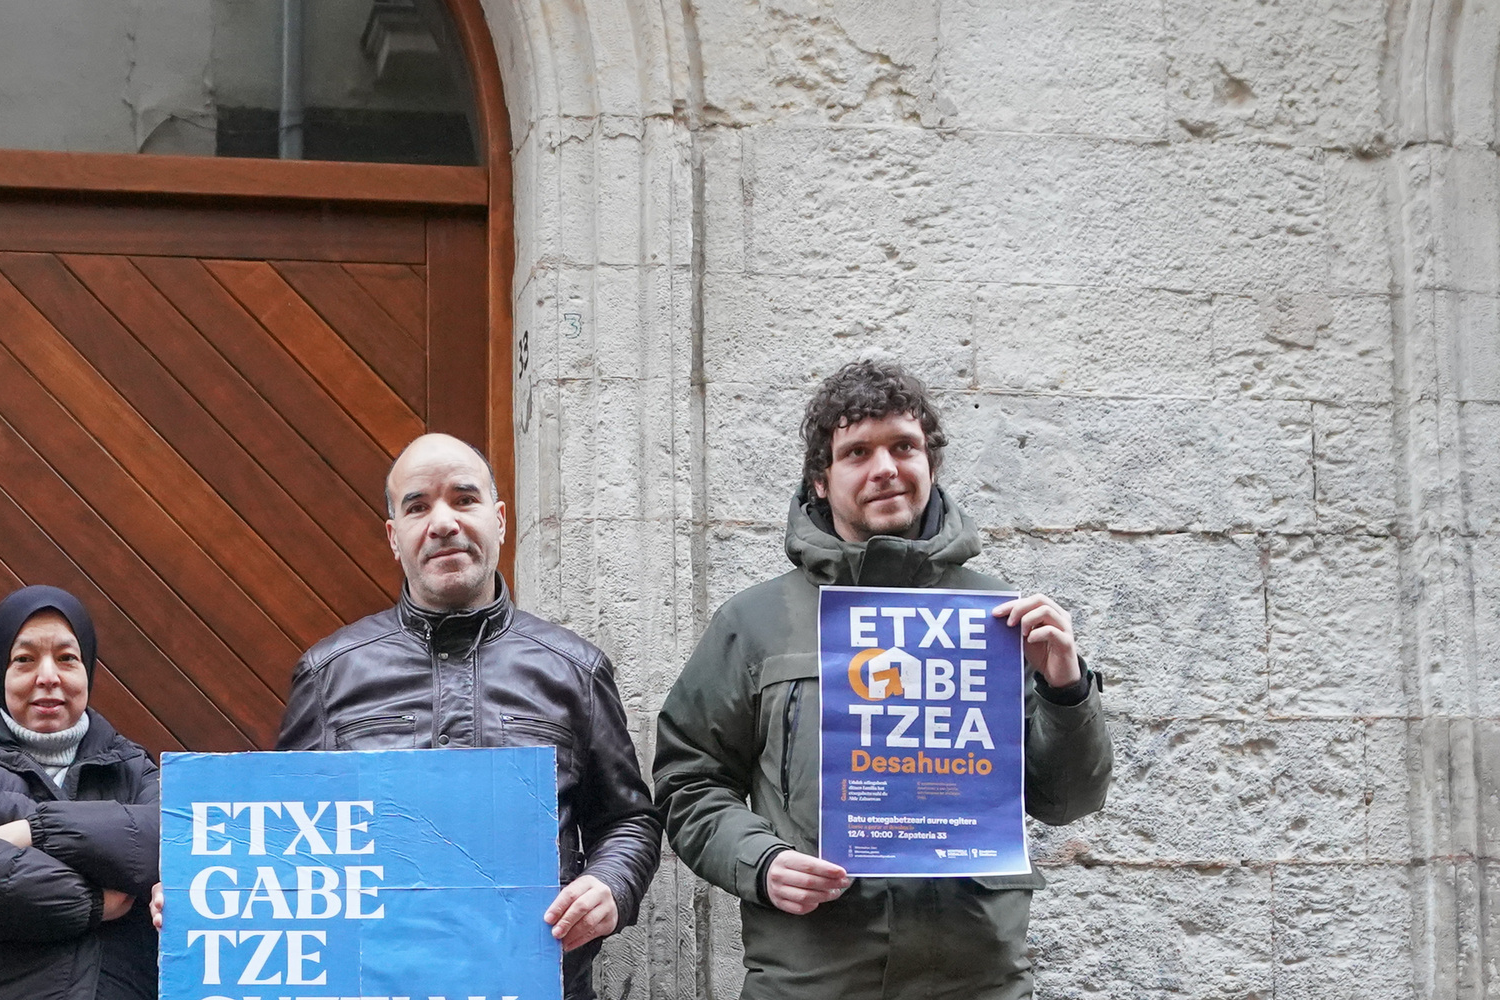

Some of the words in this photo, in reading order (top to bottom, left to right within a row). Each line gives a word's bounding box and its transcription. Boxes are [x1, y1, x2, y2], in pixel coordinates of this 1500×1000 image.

[850, 607, 987, 650] ETXE
[848, 647, 987, 701] GABE
[849, 705, 995, 750] TZEA
[852, 751, 992, 776] Desahucio
[191, 801, 375, 856] ETXE
[848, 815, 866, 825] Batu
[867, 816, 926, 826] etxegabetzeari
[950, 817, 977, 827] egitera
[871, 831, 893, 839] 10:00
[898, 831, 936, 841] Zapateria
[937, 832, 948, 840] 33
[189, 865, 385, 920] GABE
[188, 930, 327, 985] TZE
